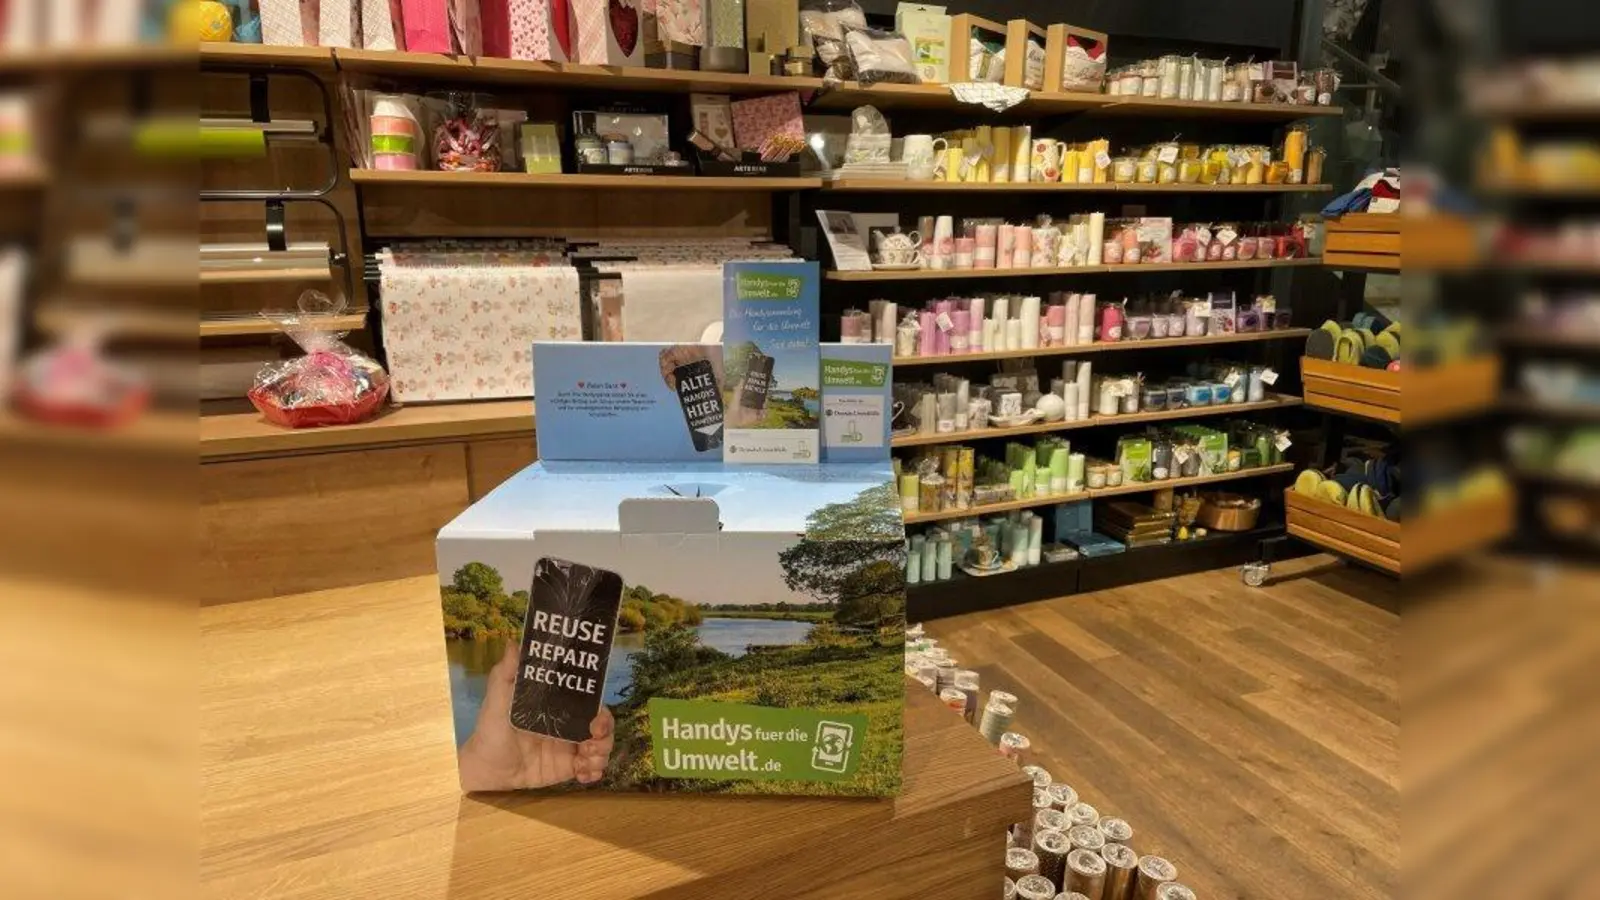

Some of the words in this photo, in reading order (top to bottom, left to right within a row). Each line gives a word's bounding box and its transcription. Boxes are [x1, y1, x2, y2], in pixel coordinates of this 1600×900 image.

[680, 372, 713, 393] ALTE
[683, 388, 716, 404] HANDYS
[686, 400, 720, 419] HIER
[533, 610, 606, 645] REUSE
[528, 640, 600, 671] REPAIR
[523, 664, 597, 694] RECYCLE
[662, 717, 753, 746] Handys
[755, 728, 784, 741] fuer
[785, 728, 809, 742] die
